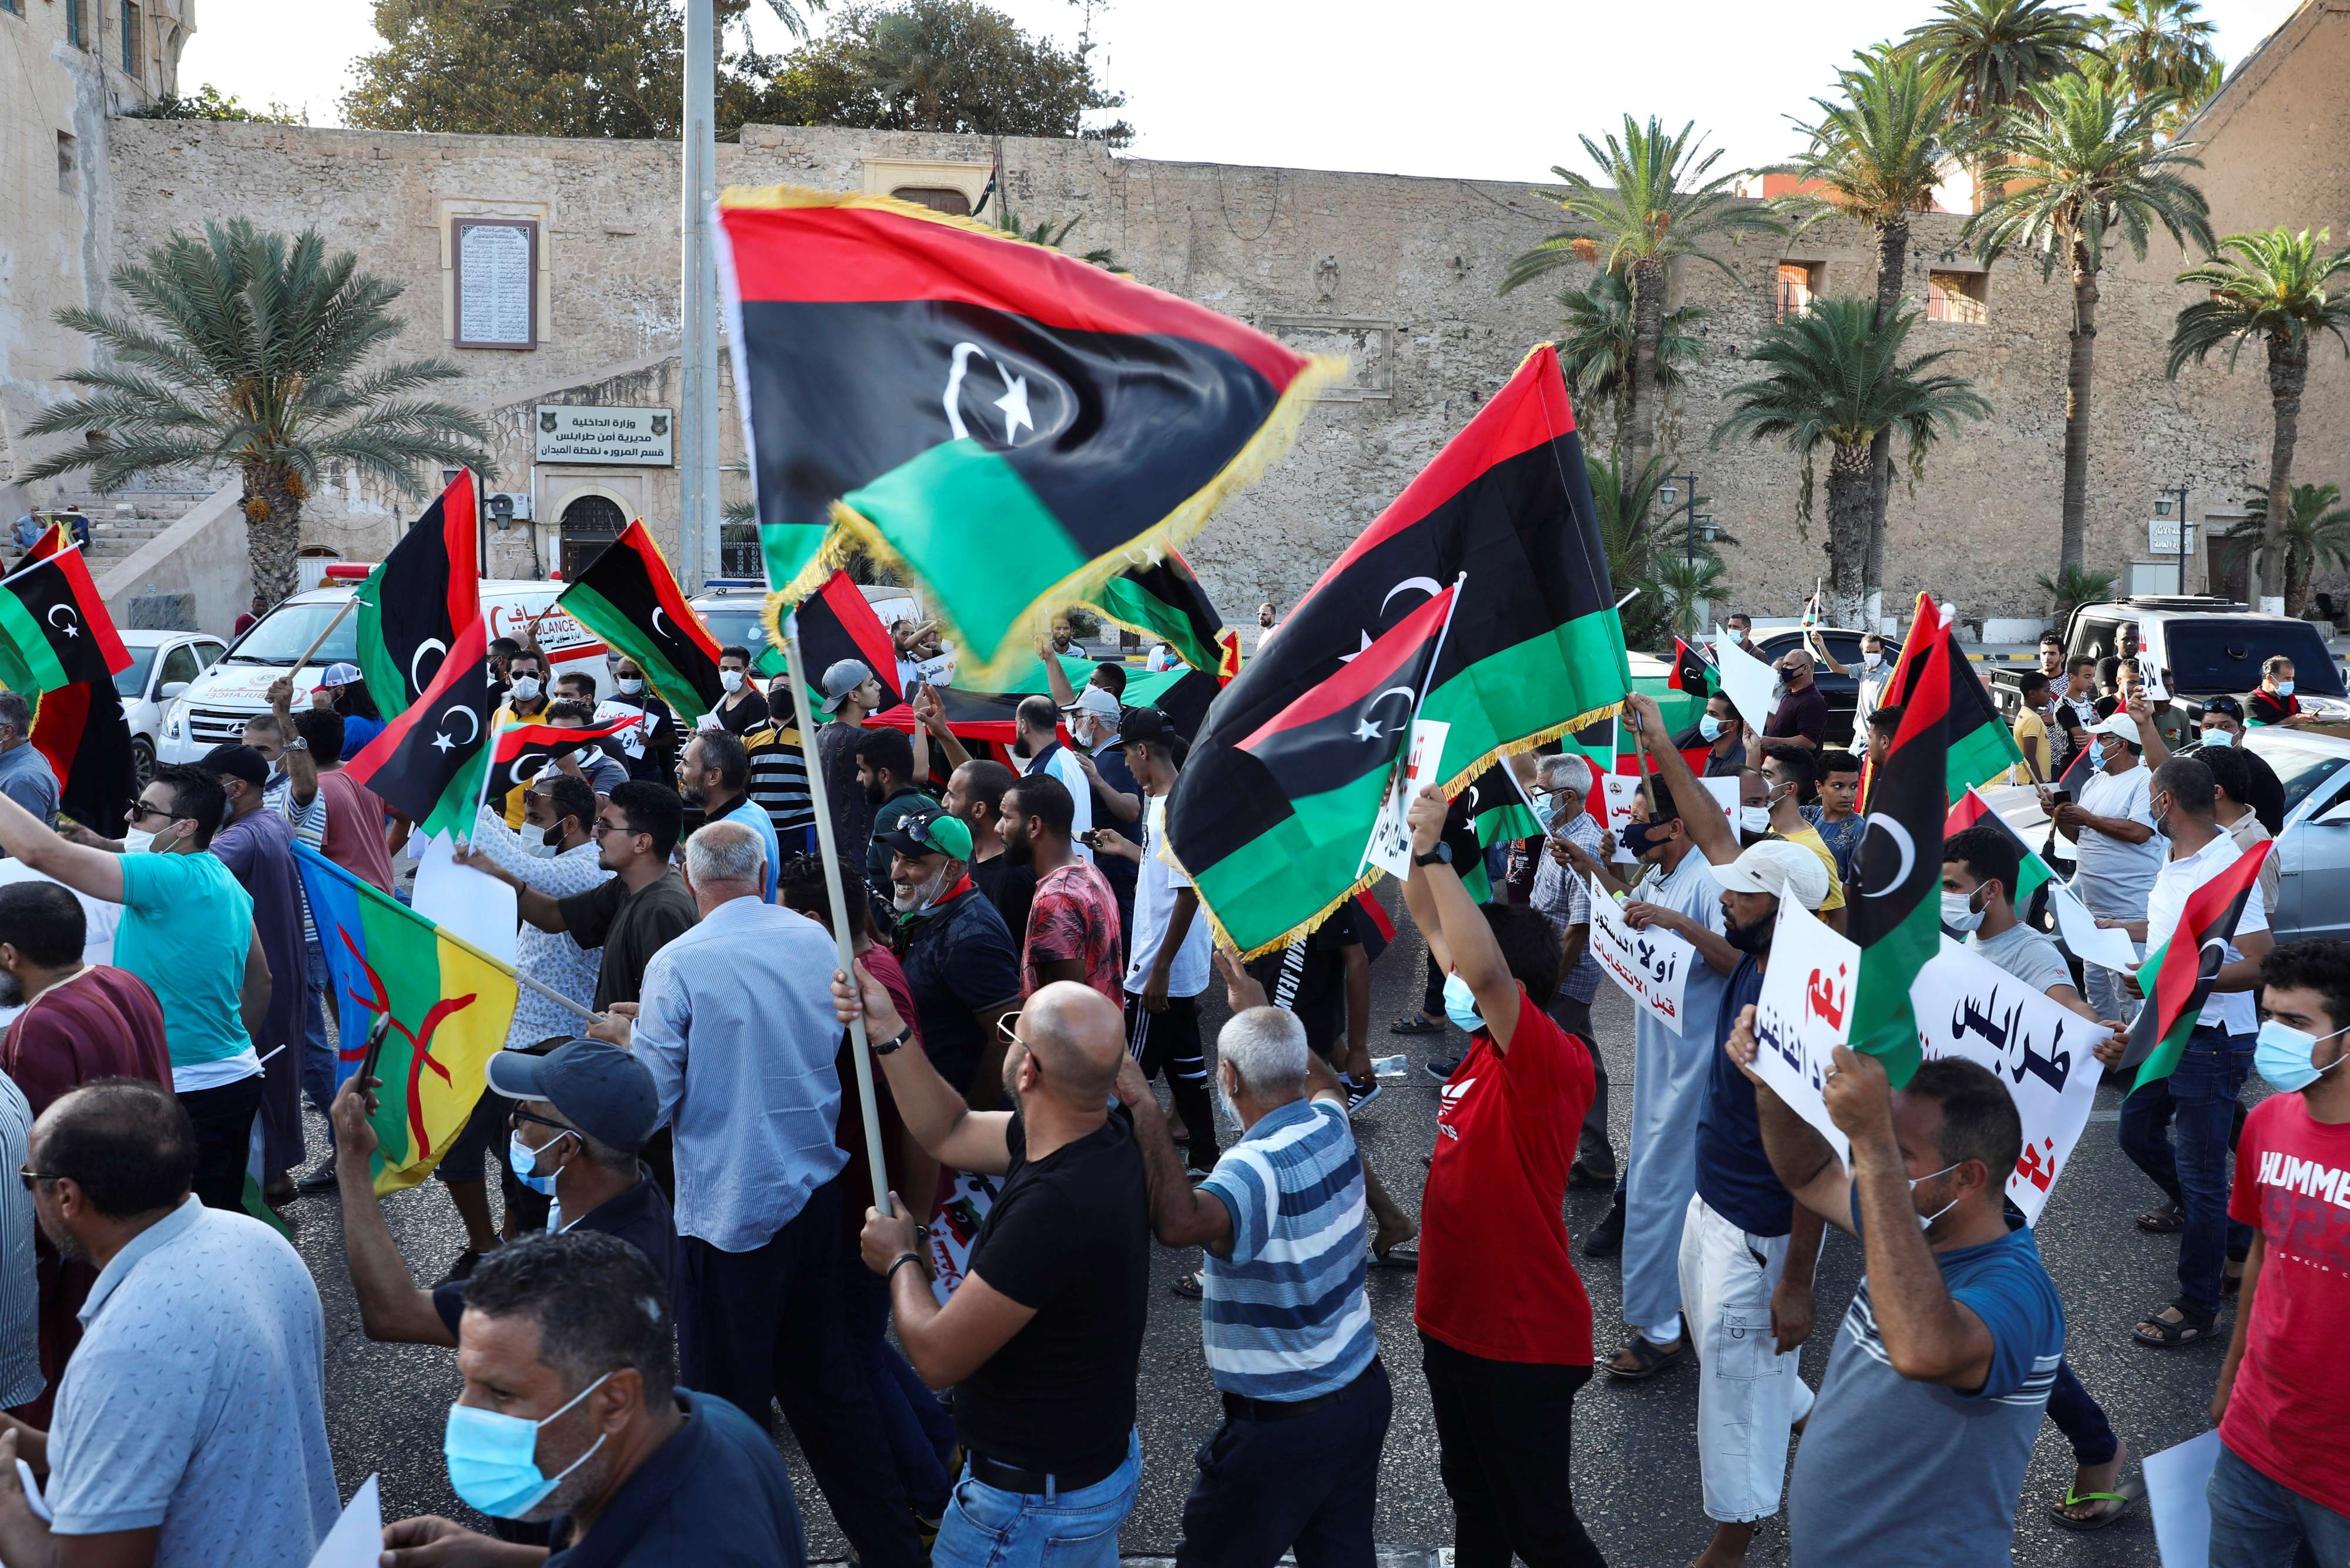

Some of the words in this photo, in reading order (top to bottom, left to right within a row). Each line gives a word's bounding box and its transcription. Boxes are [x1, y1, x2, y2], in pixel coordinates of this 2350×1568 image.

[572, 418, 610, 427] الداخلية
[613, 419, 636, 429] وزارة
[556, 432, 595, 442] طرابلس
[597, 431, 615, 442] أمن
[617, 434, 652, 443] مديرية
[541, 445, 571, 456] الميدان
[573, 446, 601, 455] نقطة
[610, 448, 638, 456] المرور
[640, 449, 664, 458] قسم
[1594, 912, 1634, 957] الدستور
[1593, 934, 1648, 997] الانتخابات
[1805, 962, 1847, 1032] نعم
[1651, 993, 1676, 1018] قبل
[1952, 982, 2071, 1094] طرابلس
